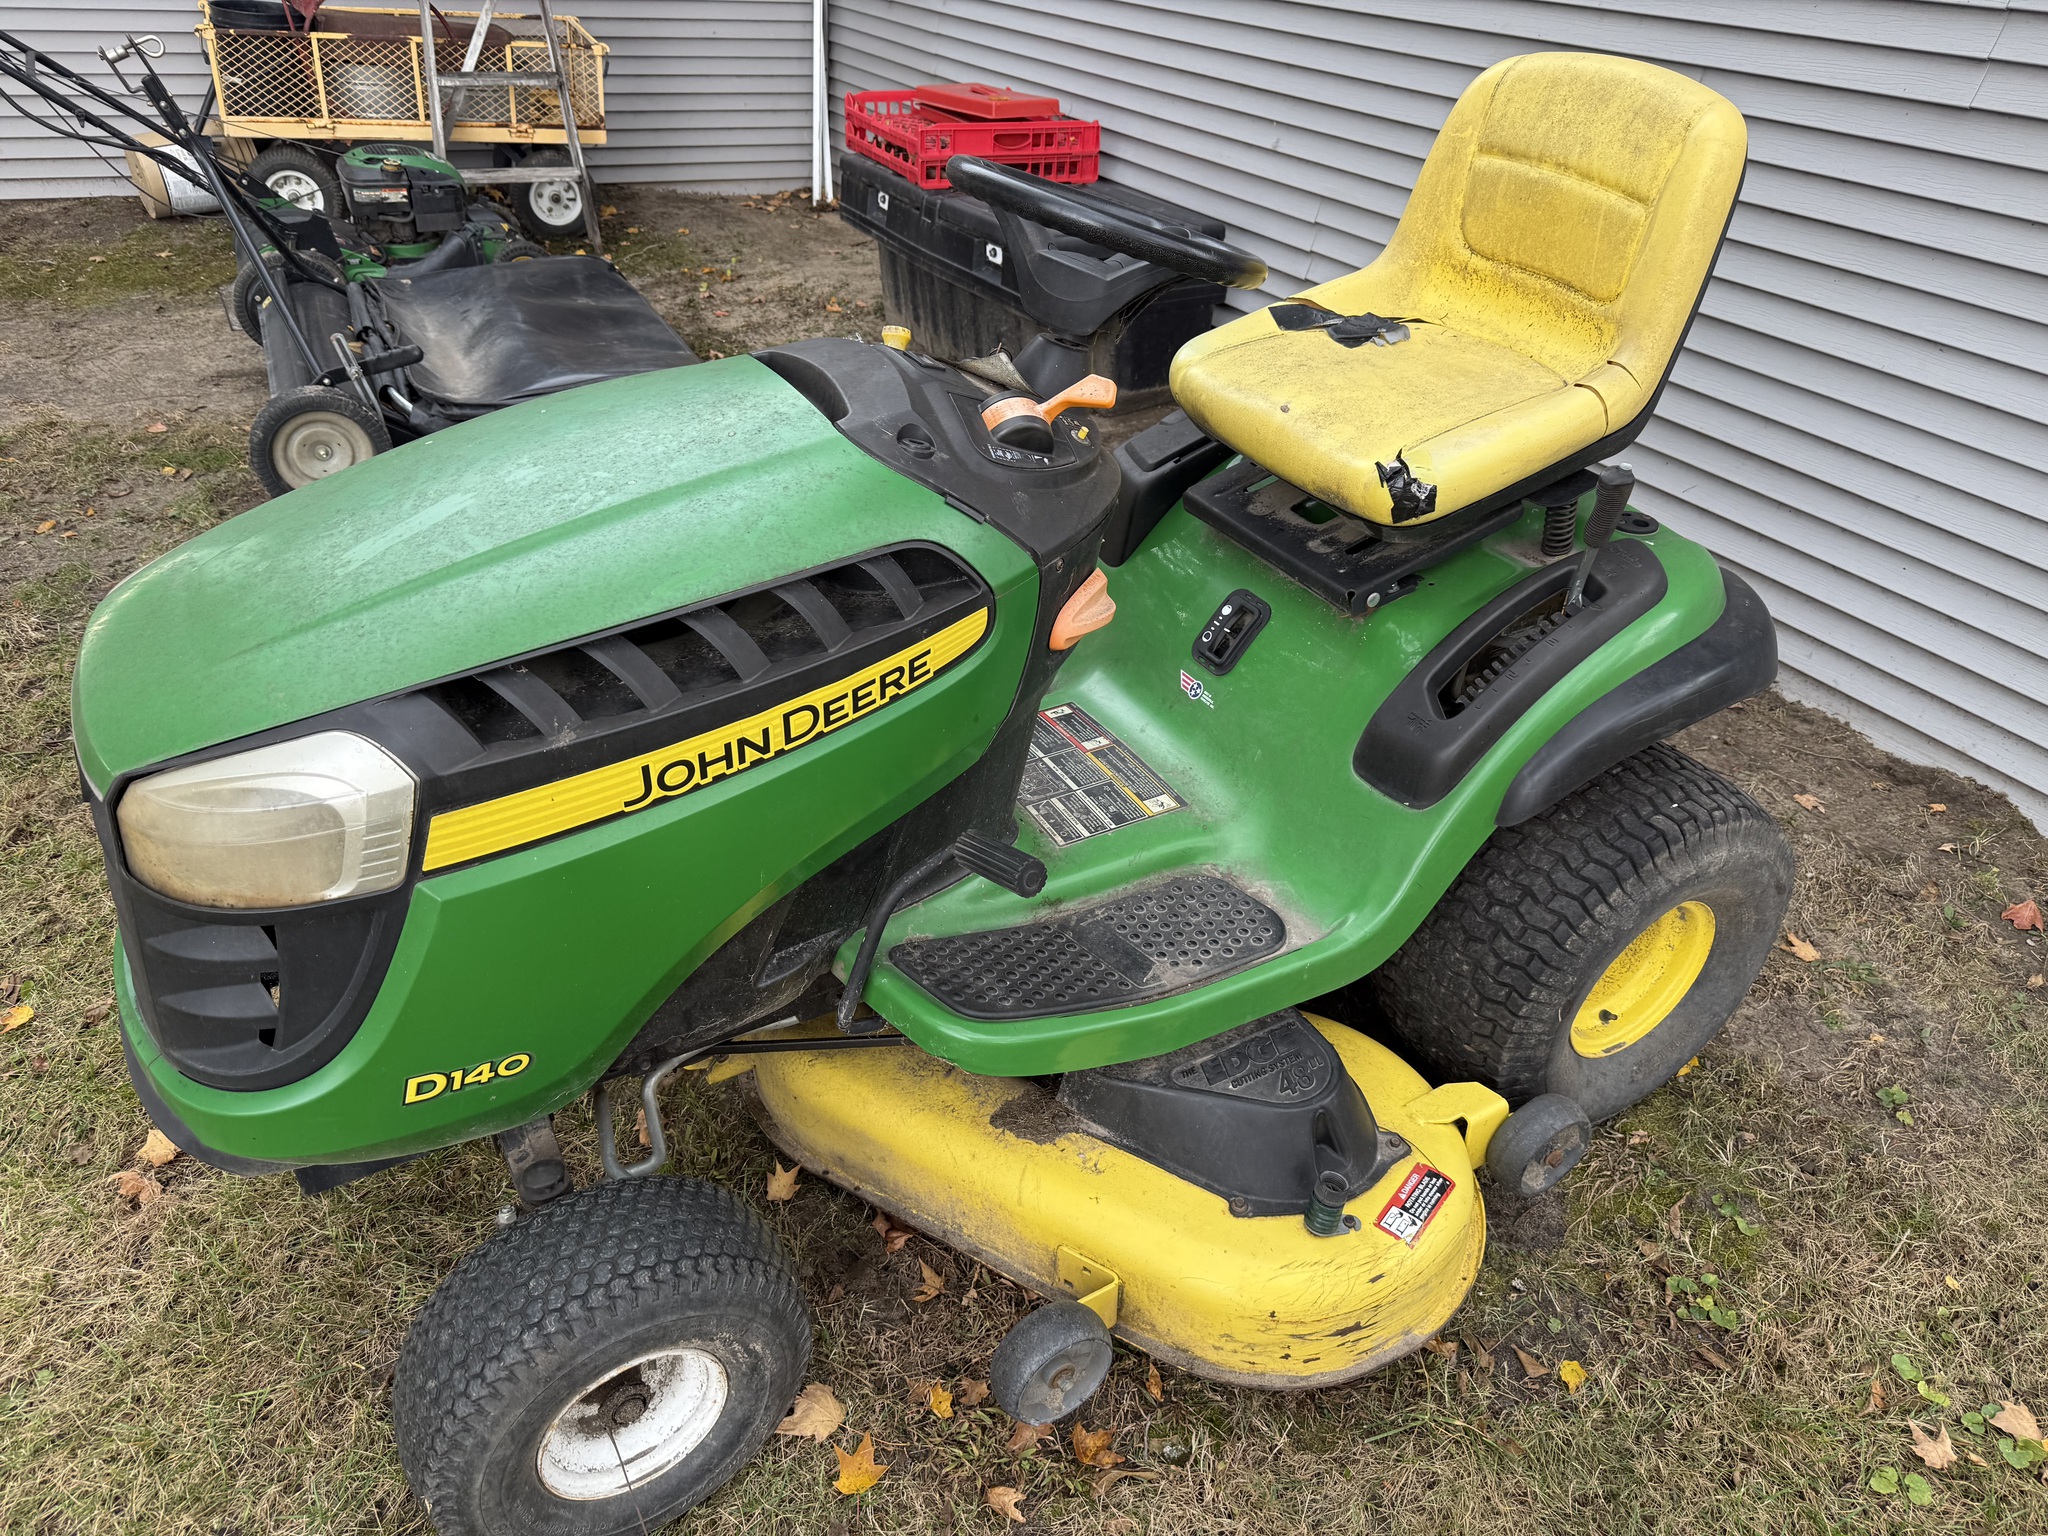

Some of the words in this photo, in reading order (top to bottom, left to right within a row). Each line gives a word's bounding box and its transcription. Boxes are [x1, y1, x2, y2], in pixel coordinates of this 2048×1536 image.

[624, 726, 770, 808] JOHN
[782, 648, 932, 746] DEERE
[403, 1053, 532, 1105] D140
[1181, 1065, 1198, 1079] THE
[1200, 1023, 1298, 1087] EDGE
[1230, 1066, 1268, 1089] CUTTING
[1269, 1053, 1304, 1073] SYSTEM
[1401, 1173, 1420, 1196] DANGER
